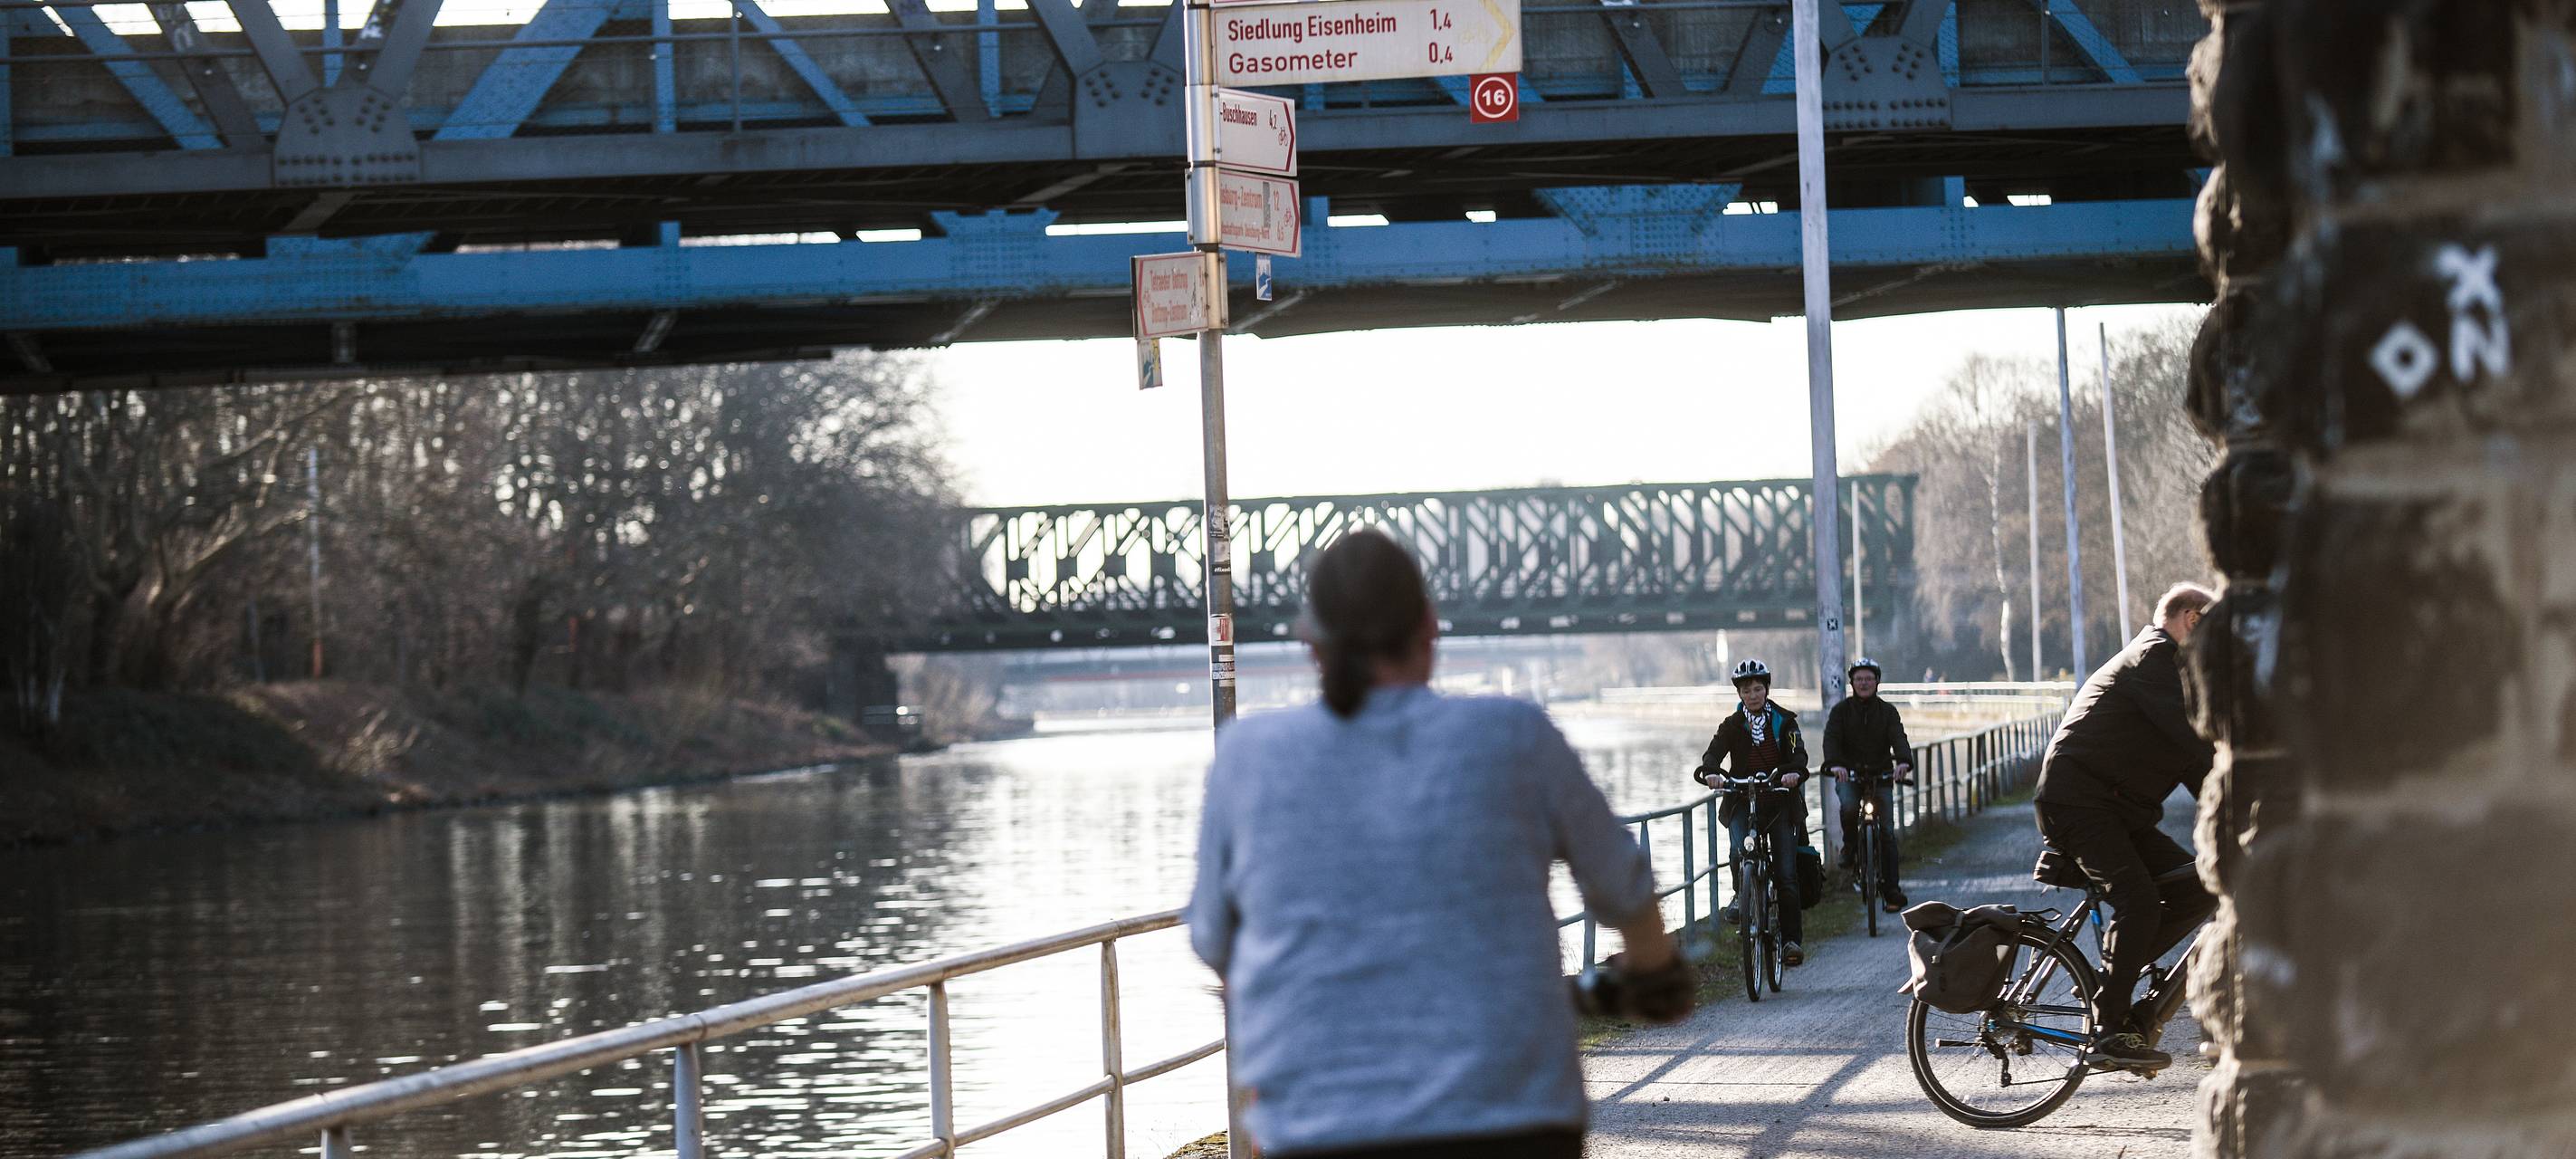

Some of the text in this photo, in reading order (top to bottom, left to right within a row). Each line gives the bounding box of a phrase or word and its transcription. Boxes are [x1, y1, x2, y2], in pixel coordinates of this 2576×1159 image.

[1227, 8, 1453, 43] Siedlung Eisenheim 1,4
[1228, 42, 1454, 74] Gasometer 0,4
[1482, 90, 1506, 107] 16
